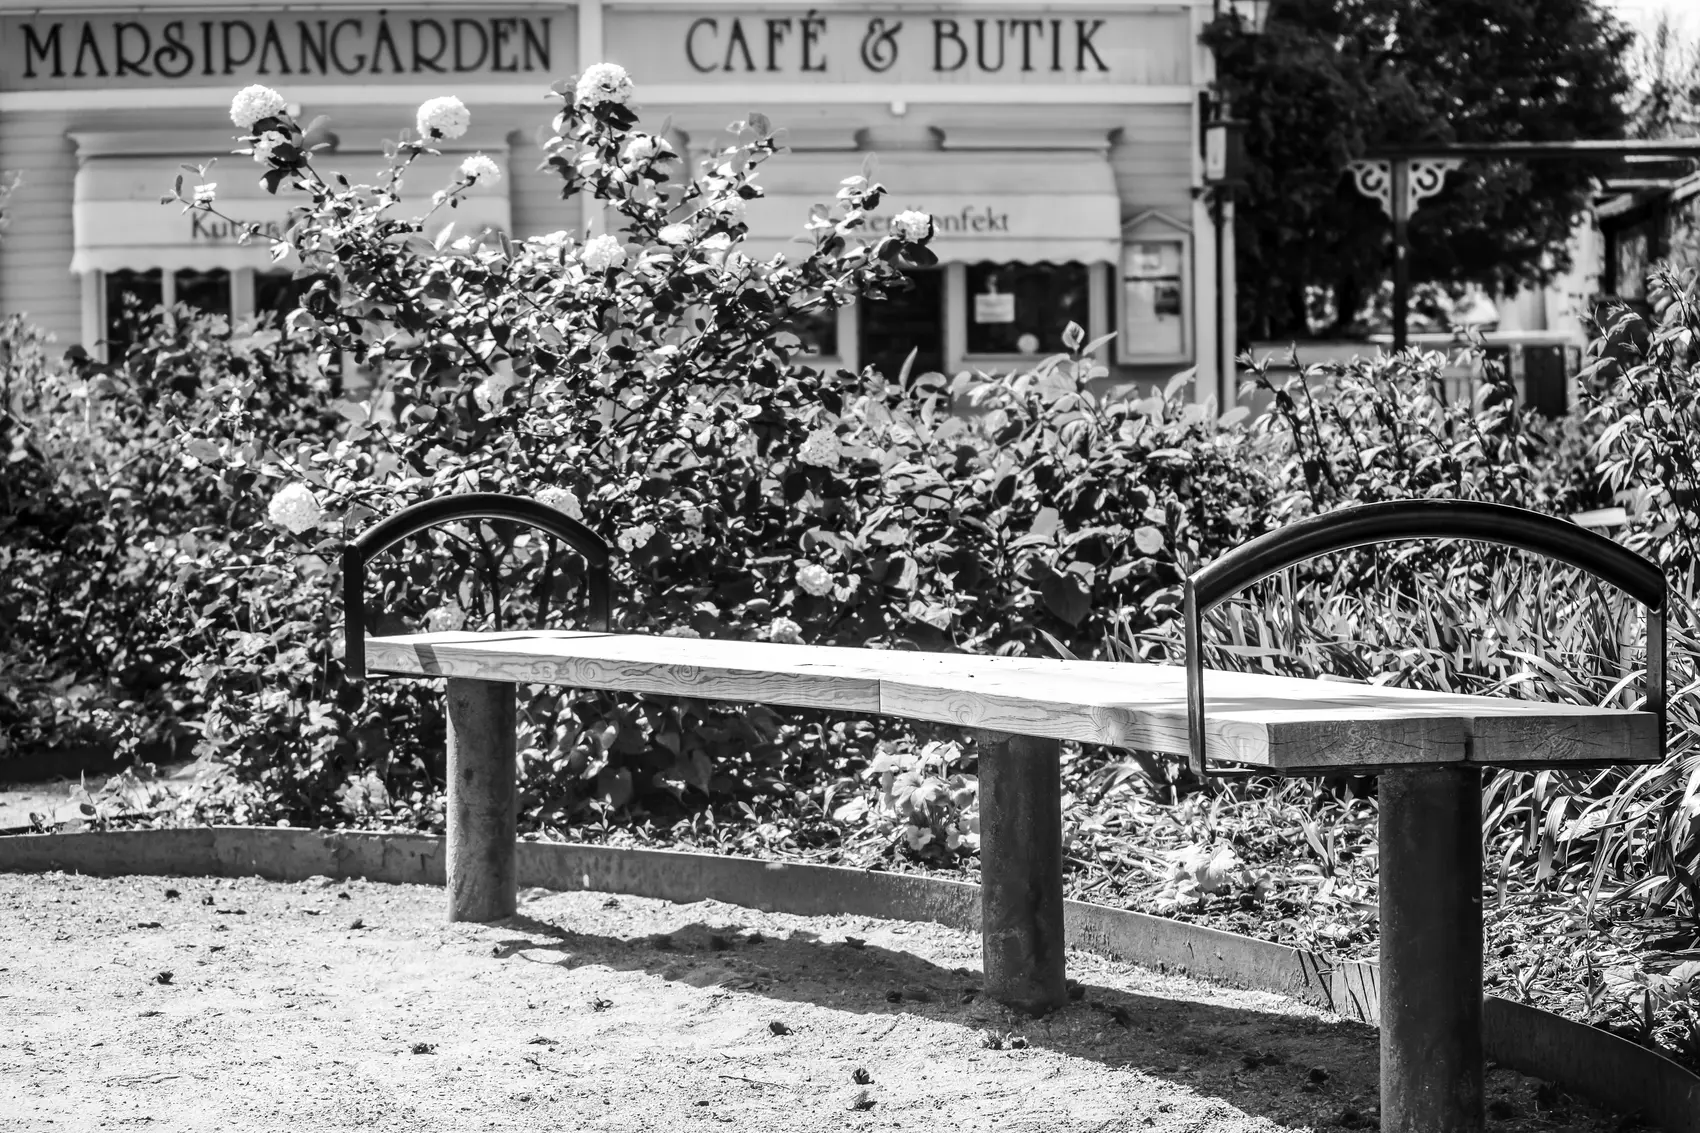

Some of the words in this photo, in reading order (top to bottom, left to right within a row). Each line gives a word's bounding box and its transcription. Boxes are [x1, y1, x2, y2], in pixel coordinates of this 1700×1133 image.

[19, 10, 552, 78] MARSIPANGÅRDEN
[685, 10, 827, 72] CAFÉ
[860, 17, 904, 72] &
[931, 18, 1110, 72] BUTIK
[906, 204, 1009, 233] nfekt
